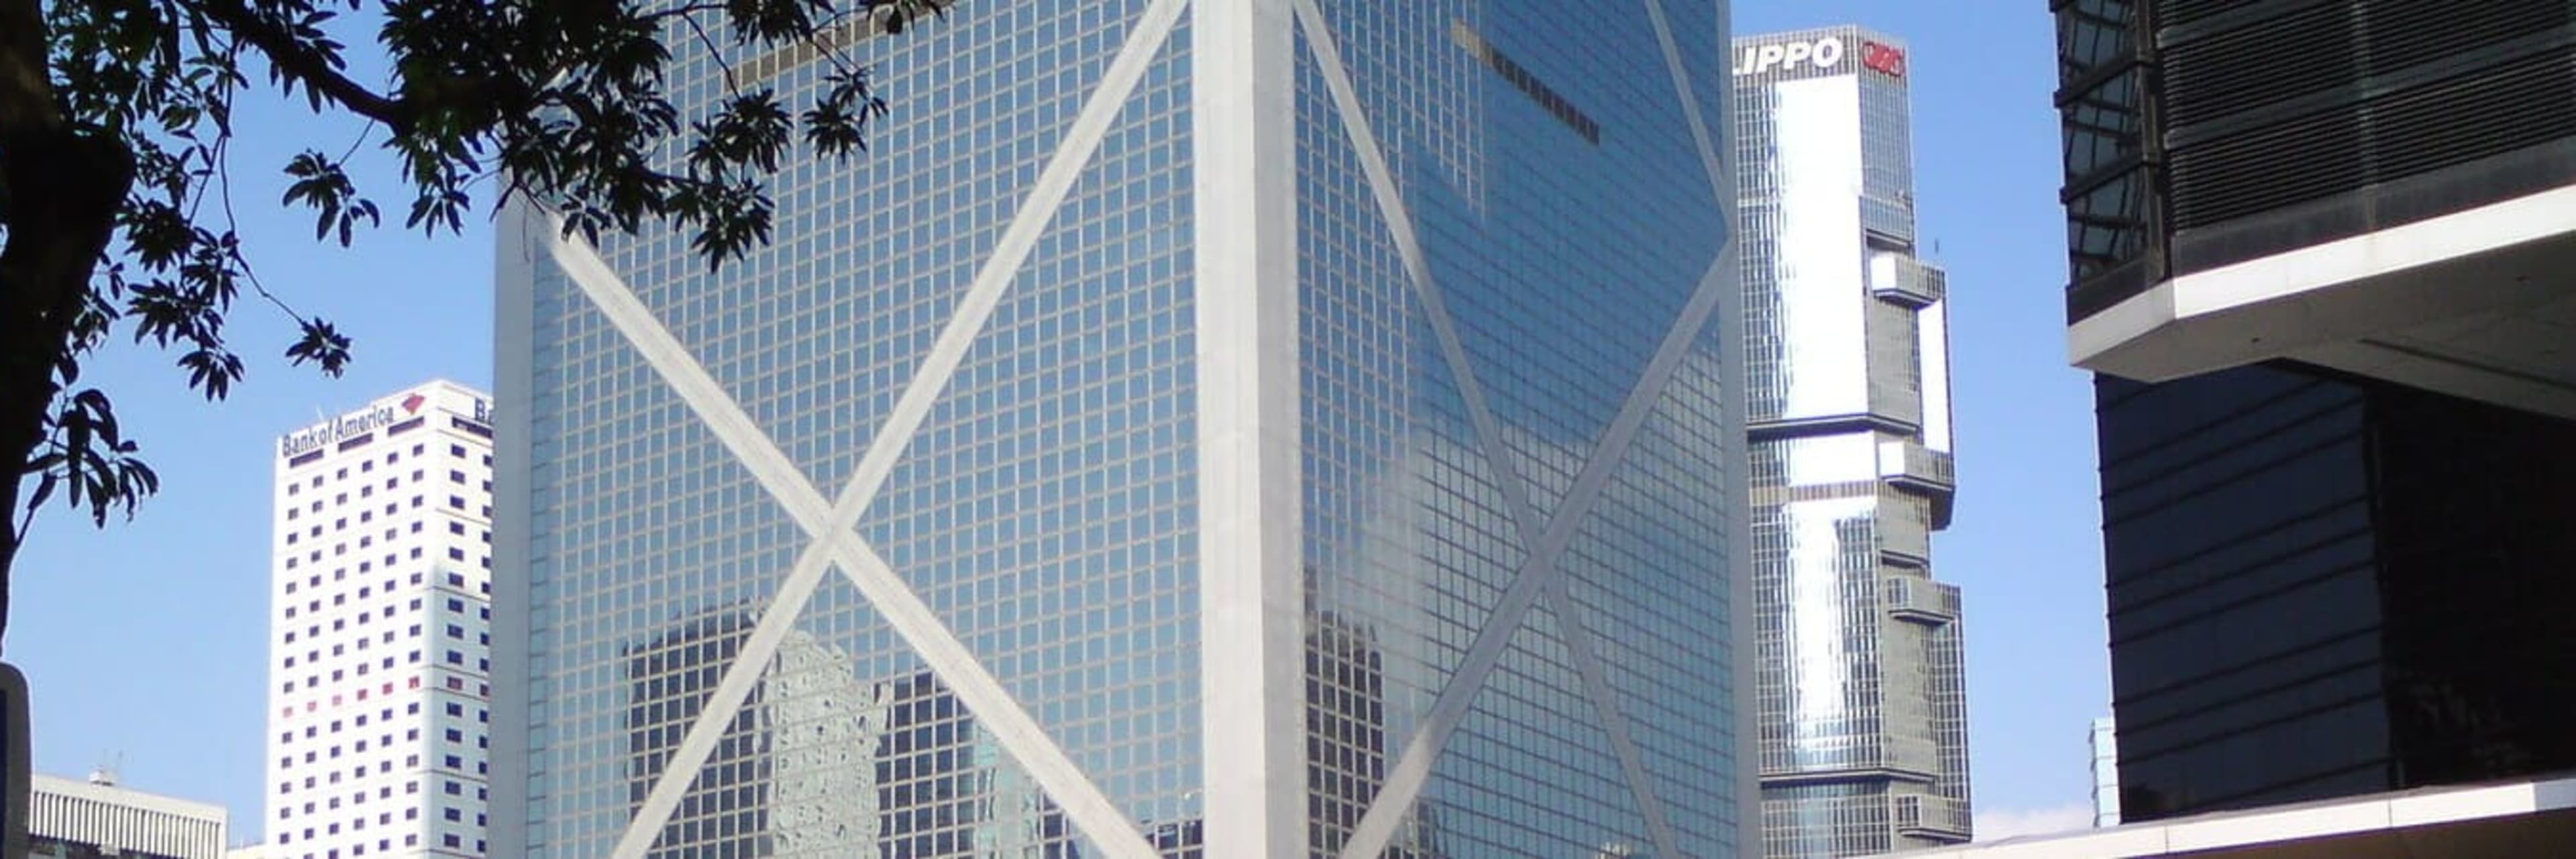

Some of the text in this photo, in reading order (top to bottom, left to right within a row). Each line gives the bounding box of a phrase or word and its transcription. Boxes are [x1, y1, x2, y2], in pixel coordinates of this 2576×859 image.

[282, 405, 394, 457] Bank of America
